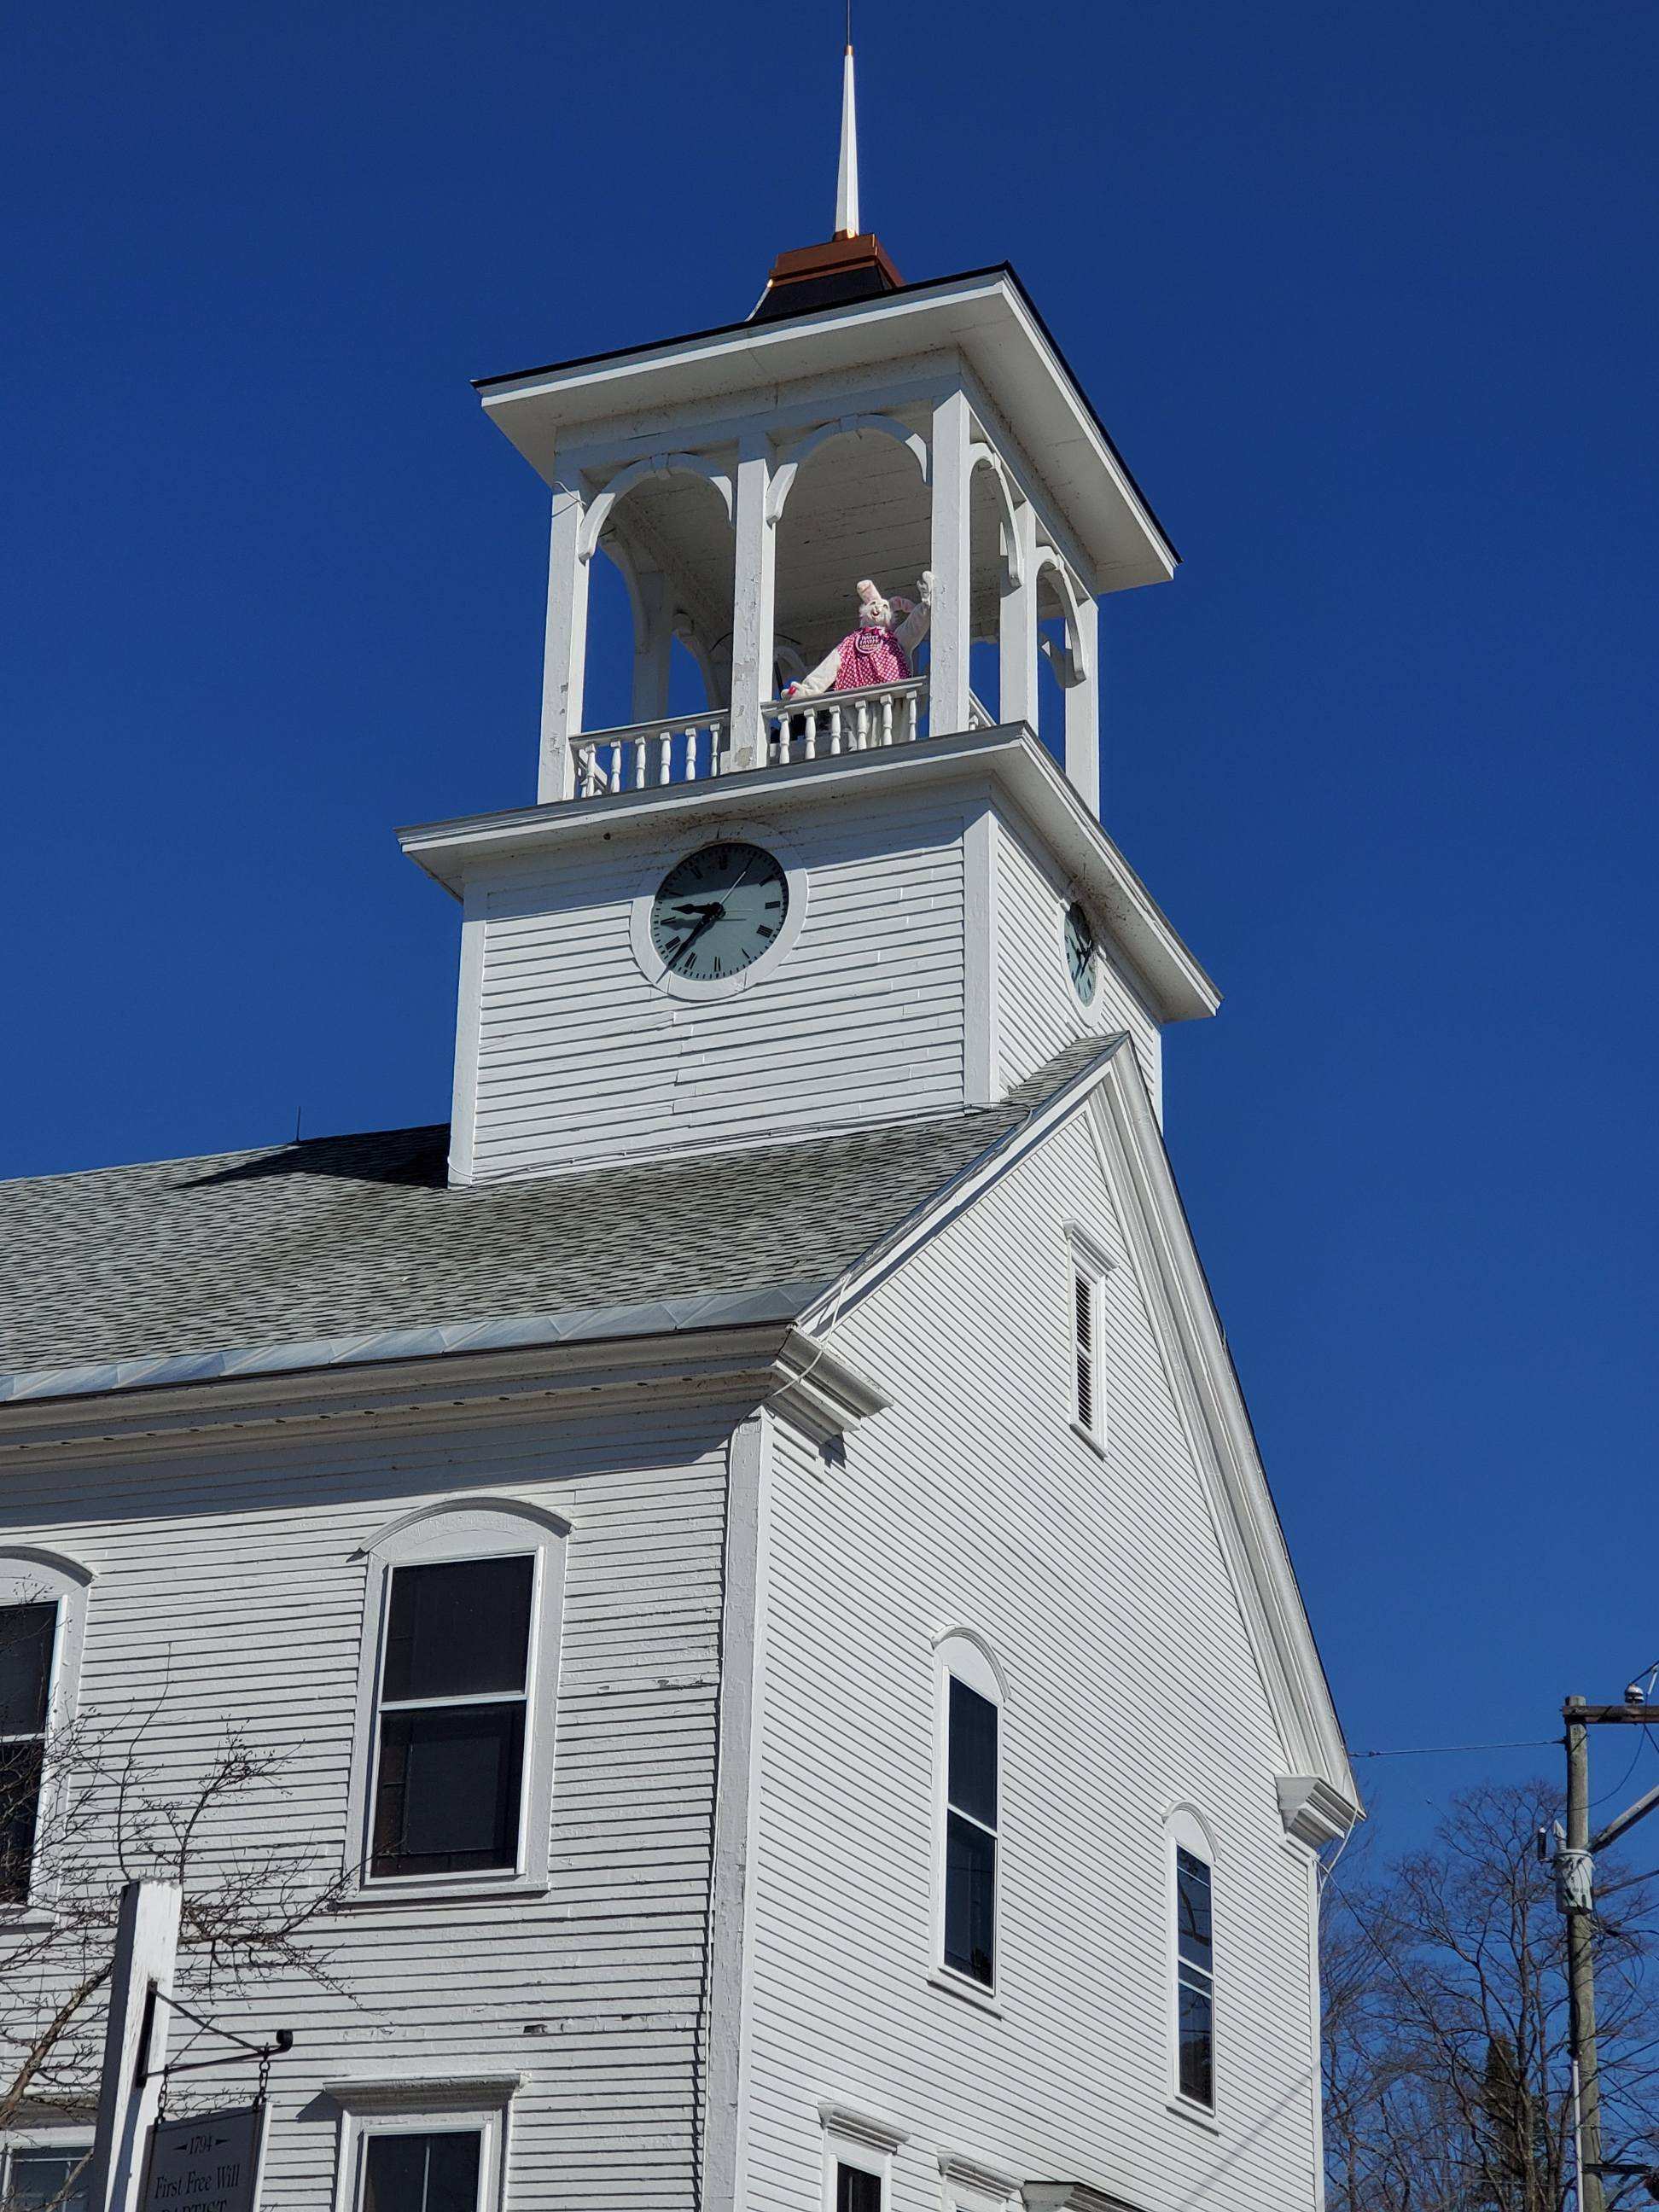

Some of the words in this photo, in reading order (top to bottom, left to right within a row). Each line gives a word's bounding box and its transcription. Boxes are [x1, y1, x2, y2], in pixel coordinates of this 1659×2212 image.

[189, 2134, 212, 2155] 1794
[154, 2176, 182, 2199] First
[185, 2170, 212, 2195] Free
[217, 2163, 241, 2190] Will
